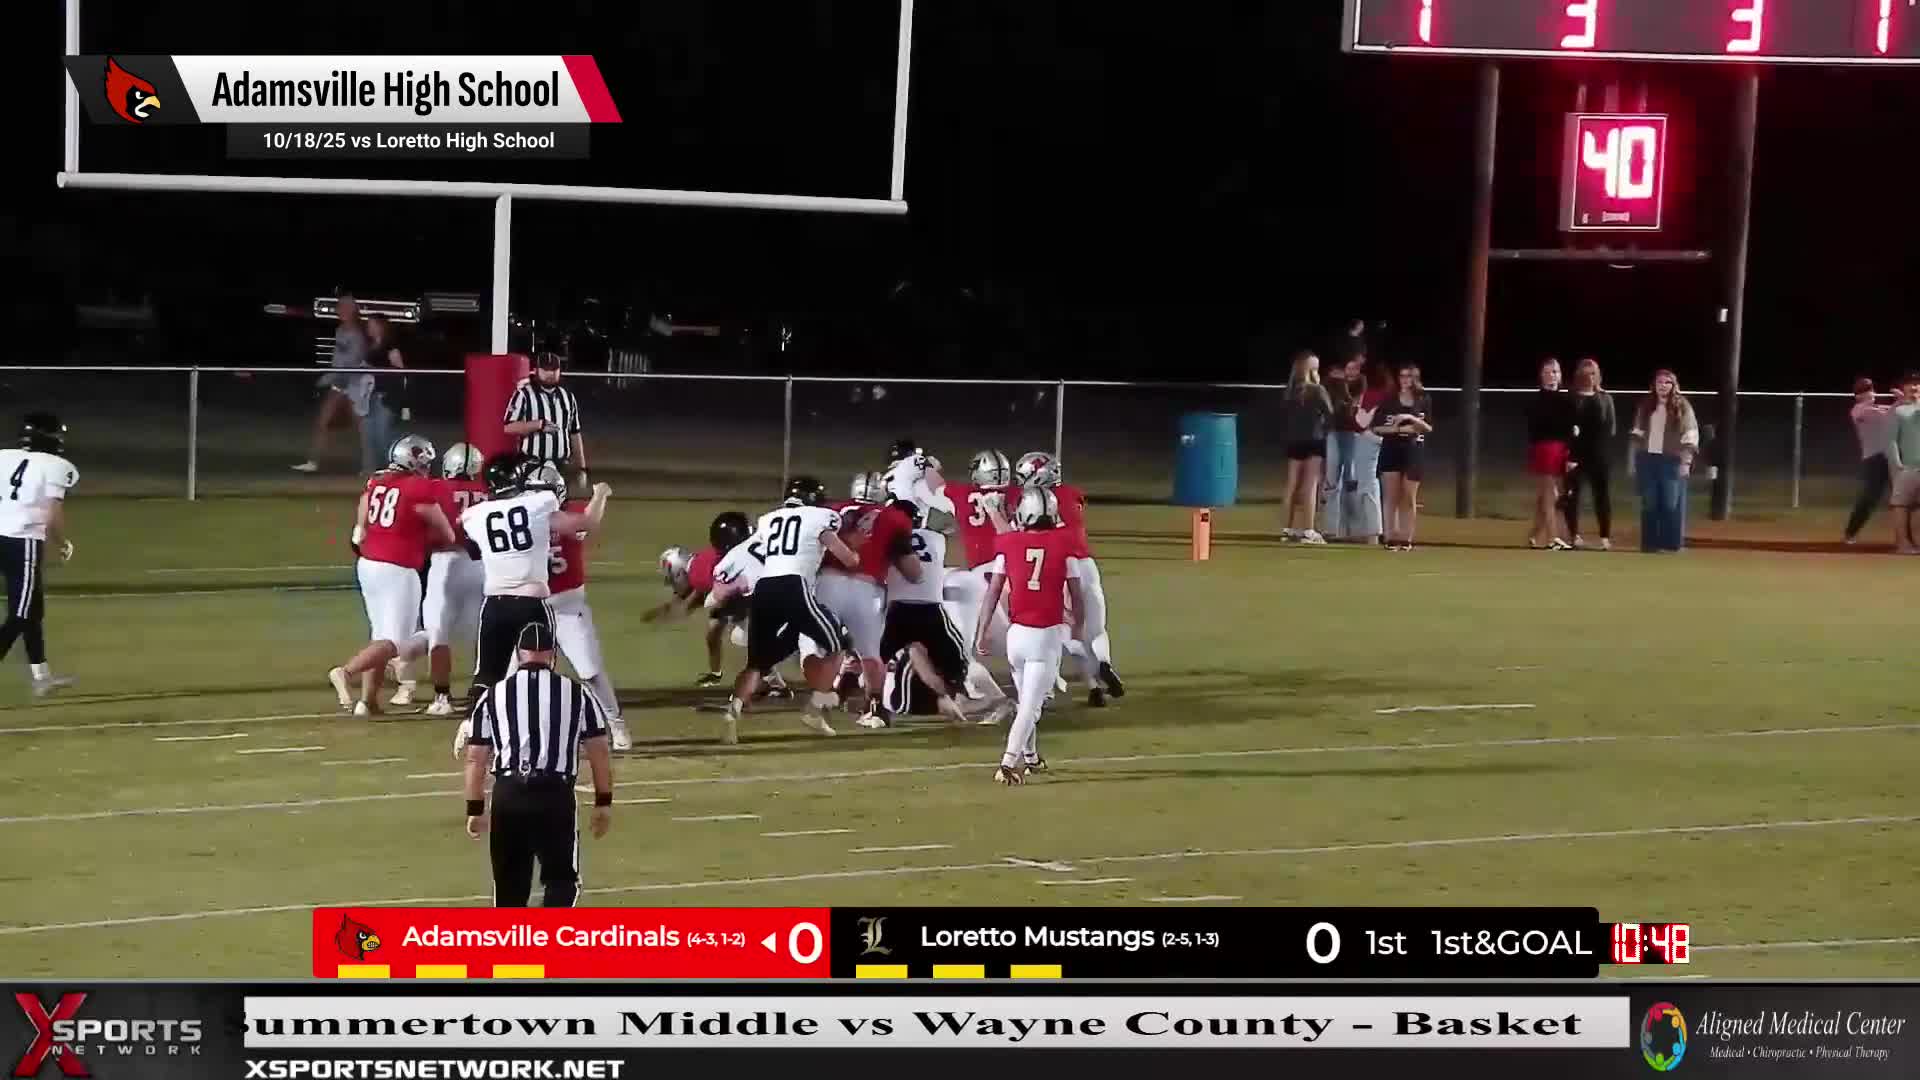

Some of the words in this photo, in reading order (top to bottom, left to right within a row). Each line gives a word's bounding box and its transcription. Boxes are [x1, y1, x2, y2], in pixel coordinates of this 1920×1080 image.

[1583, 126, 1657, 200] 40
[10, 459, 28, 501] 4
[368, 486, 400, 528] 58
[486, 505, 534, 553] 68
[767, 514, 801, 556] 20
[1026, 548, 1045, 591] 7
